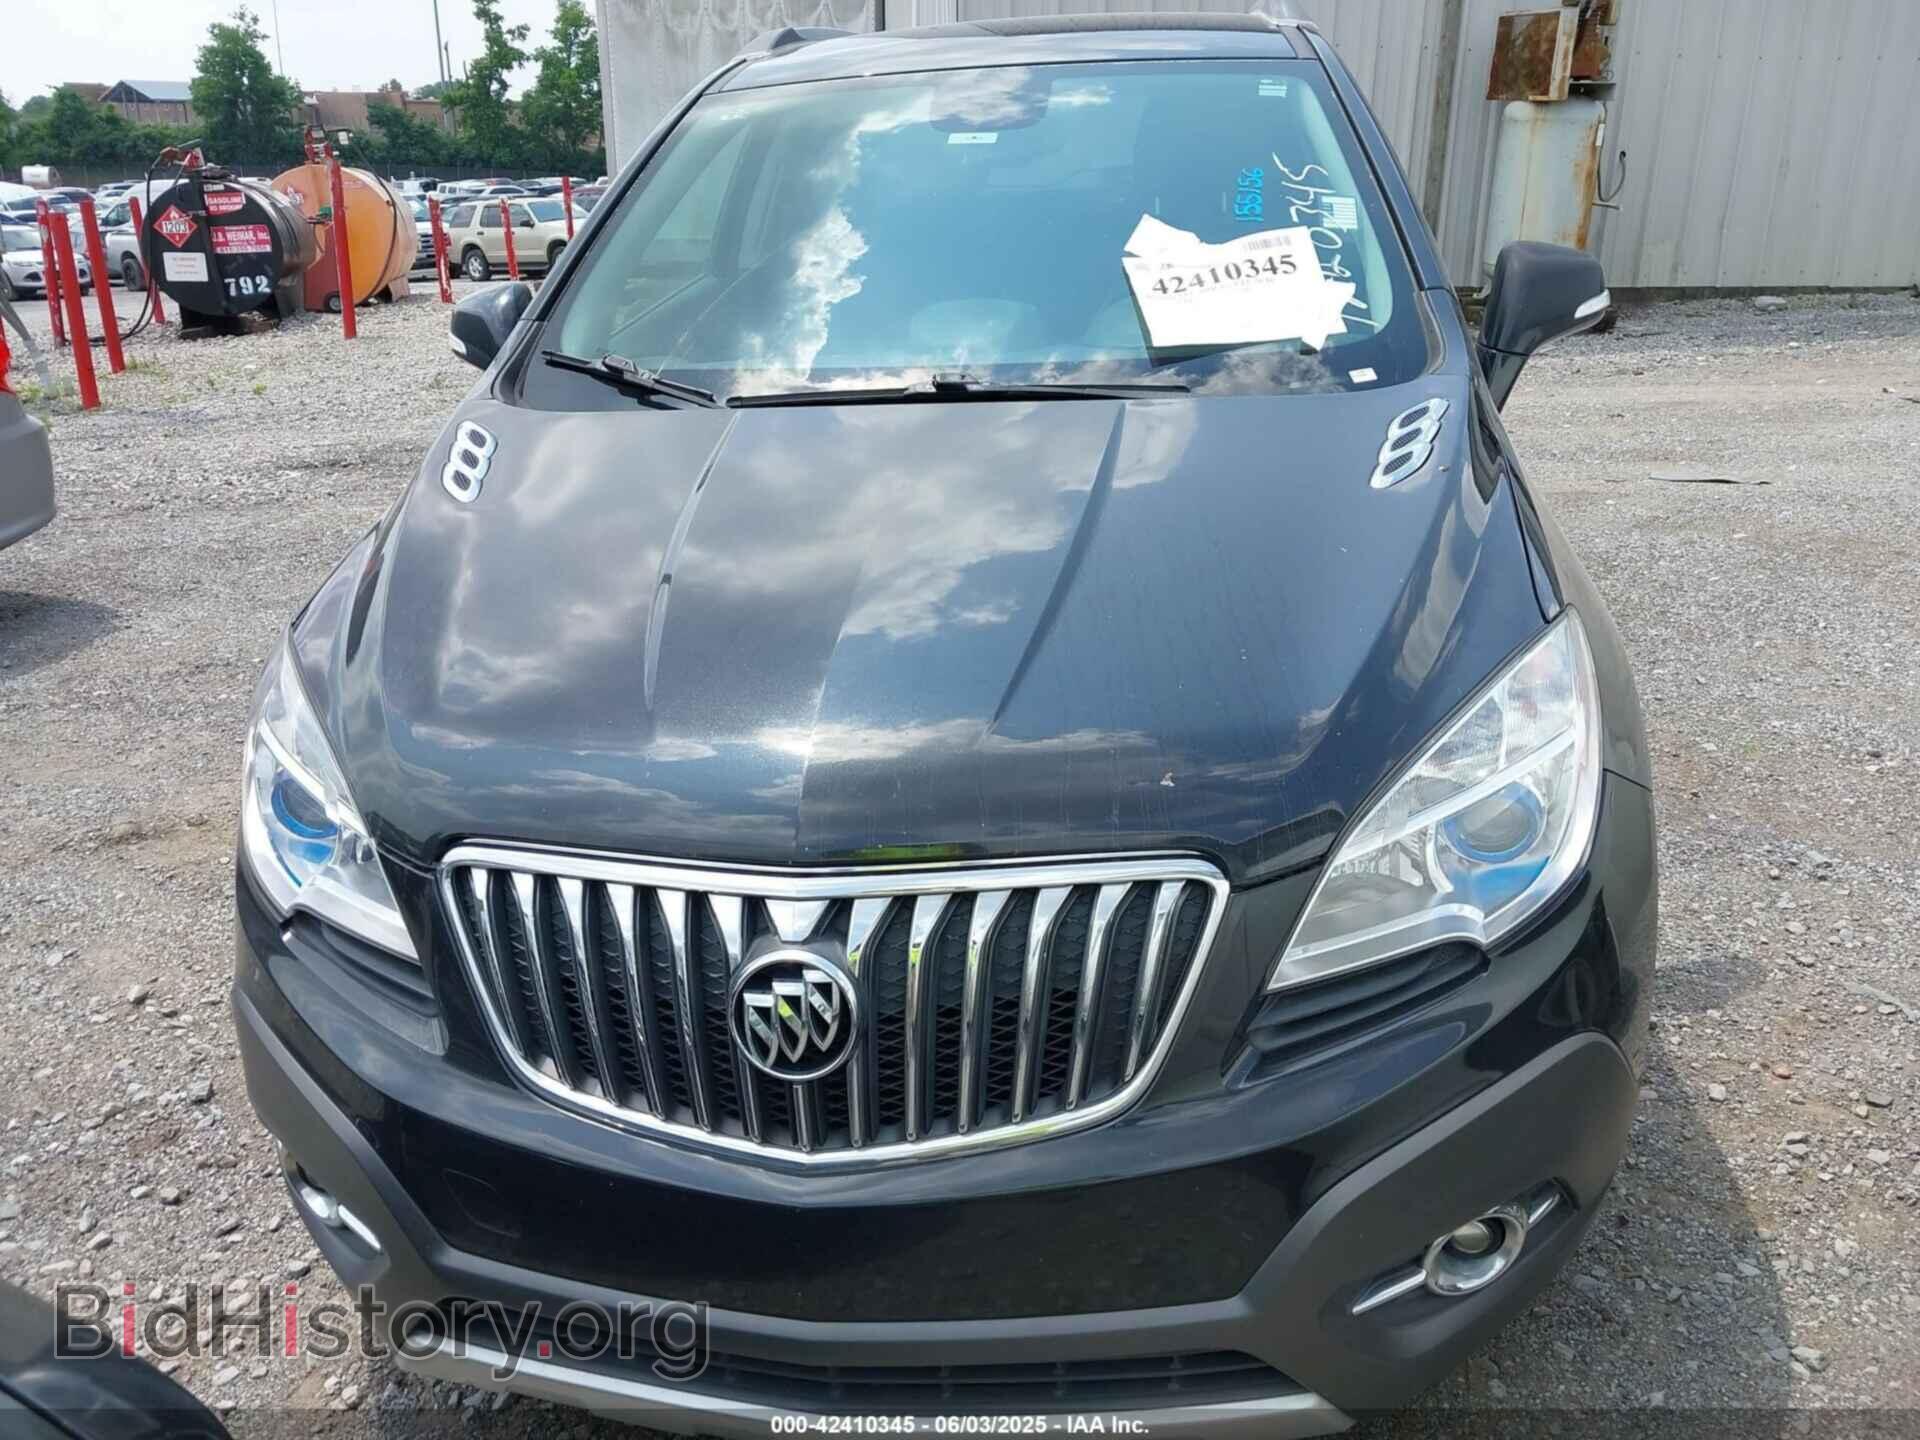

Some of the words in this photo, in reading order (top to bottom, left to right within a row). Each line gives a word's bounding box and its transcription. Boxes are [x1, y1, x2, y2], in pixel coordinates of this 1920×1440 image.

[163, 221, 187, 232] 1203
[1152, 254, 1297, 295] 42410345
[224, 275, 271, 296] 792
